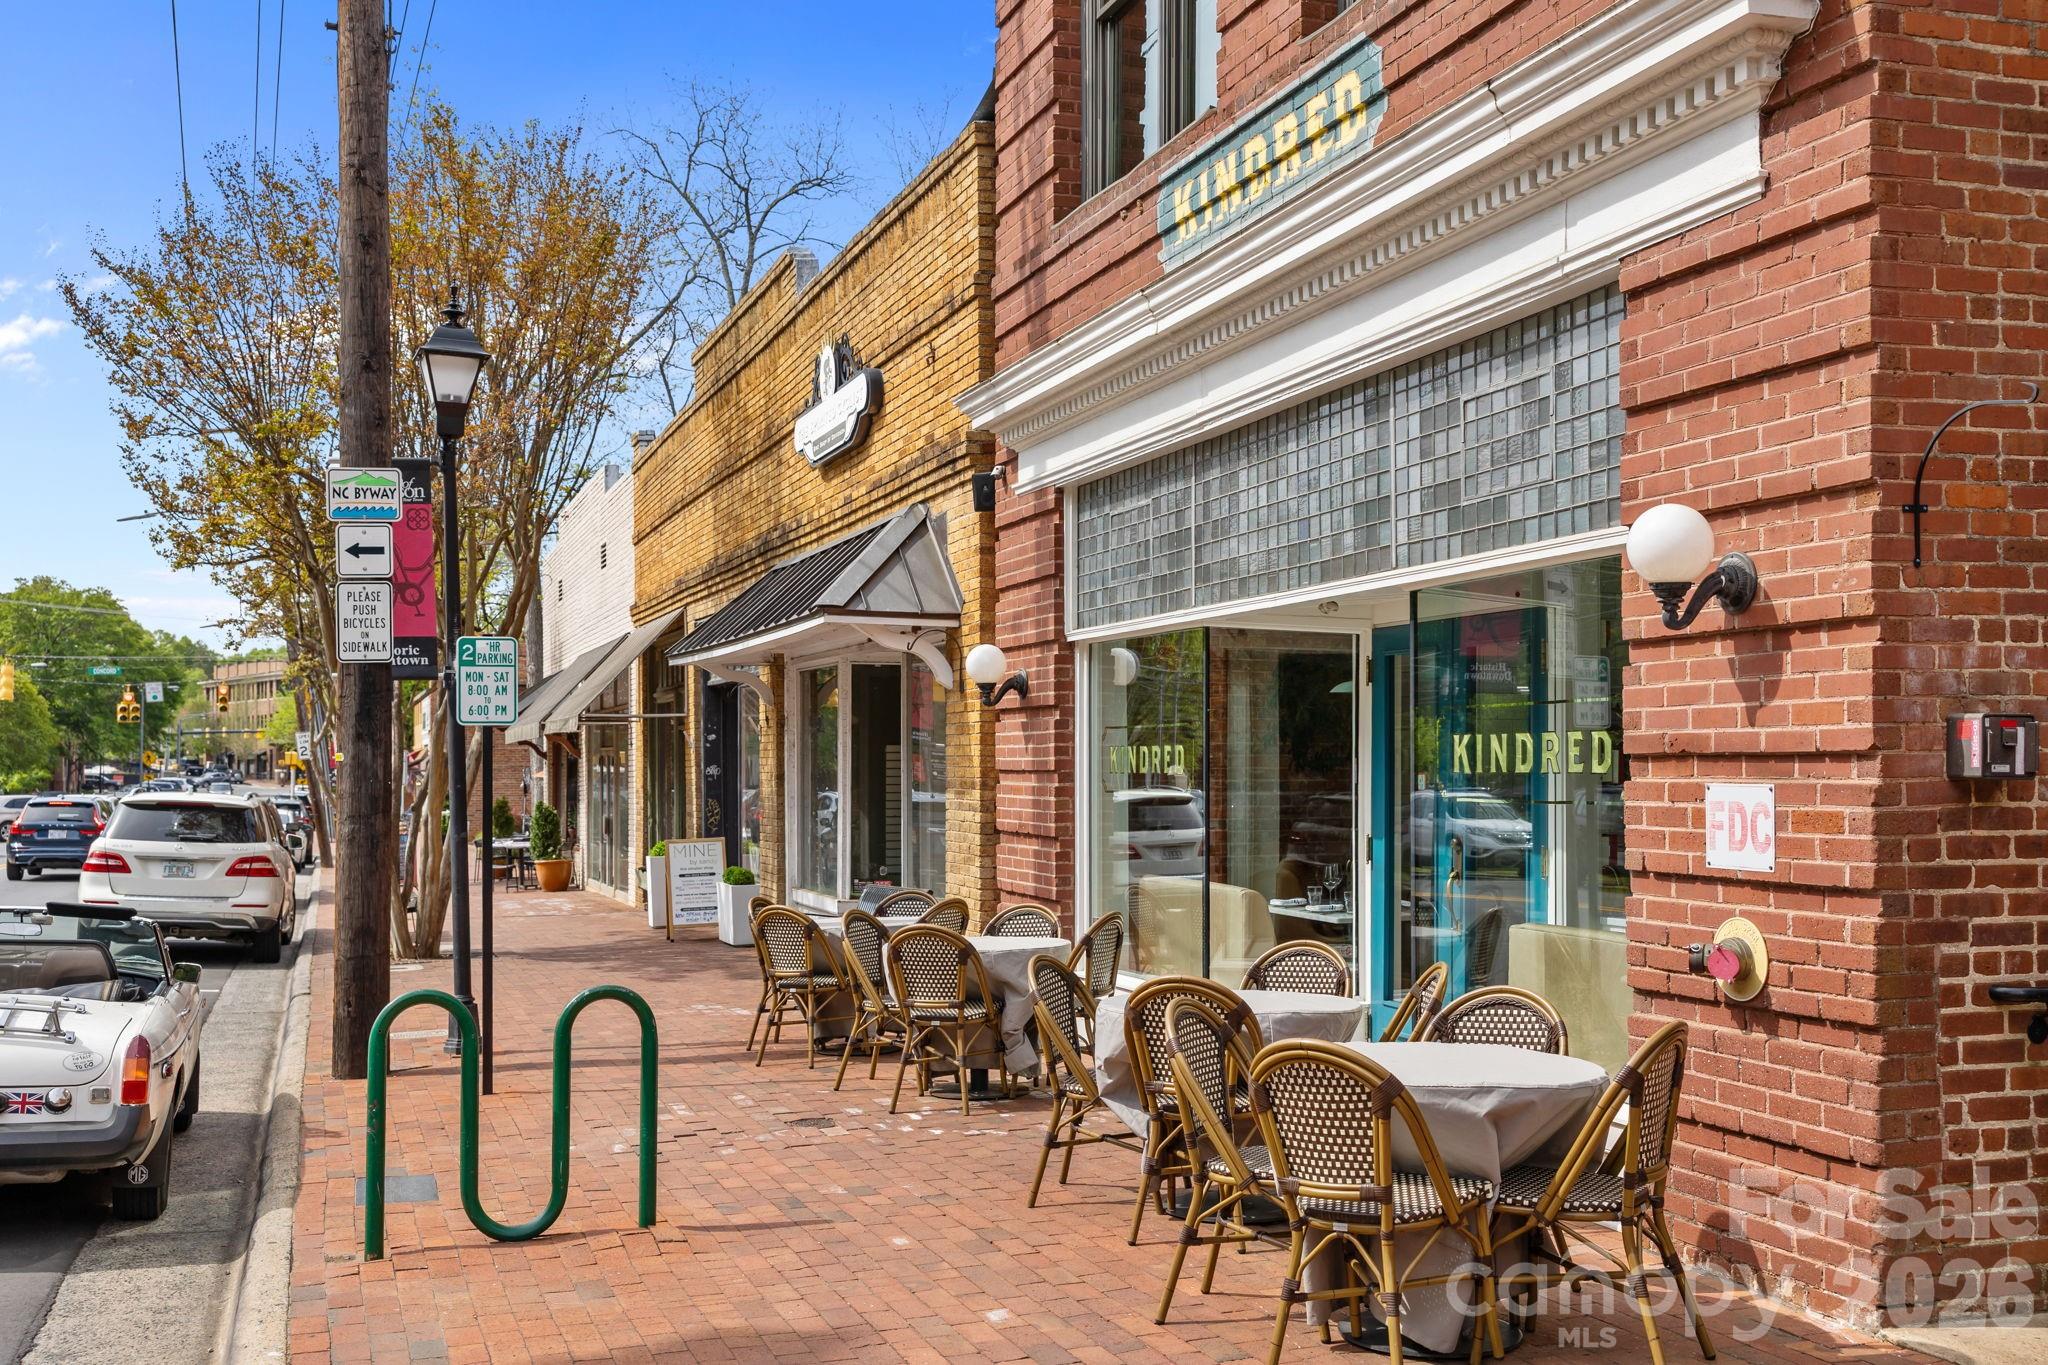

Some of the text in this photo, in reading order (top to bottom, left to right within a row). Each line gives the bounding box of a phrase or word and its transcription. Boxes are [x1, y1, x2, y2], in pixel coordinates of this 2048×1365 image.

[1173, 69, 1368, 246] KINDRED
[332, 486, 397, 499] NC BYWAY
[347, 591, 381, 602] PLEASE
[353, 604, 377, 615] PUSH
[343, 617, 386, 629] BICYCLES
[360, 631, 370, 640] ON
[342, 641, 388, 653] SIDEWALK
[394, 645, 420, 656] oric
[462, 641, 501, 660] 2 HR
[477, 653, 513, 664] PARKING
[465, 671, 484, 682] MON
[493, 671, 509, 682] SAT
[467, 684, 508, 696] 8:00 AM
[468, 705, 507, 716] 6:00 PM
[1453, 731, 1613, 774] KINDRED
[1110, 745, 1185, 775] KINDRED
[1709, 800, 1772, 855] FDC
[673, 843, 717, 858] MINE
[128, 1165, 148, 1184] MG
